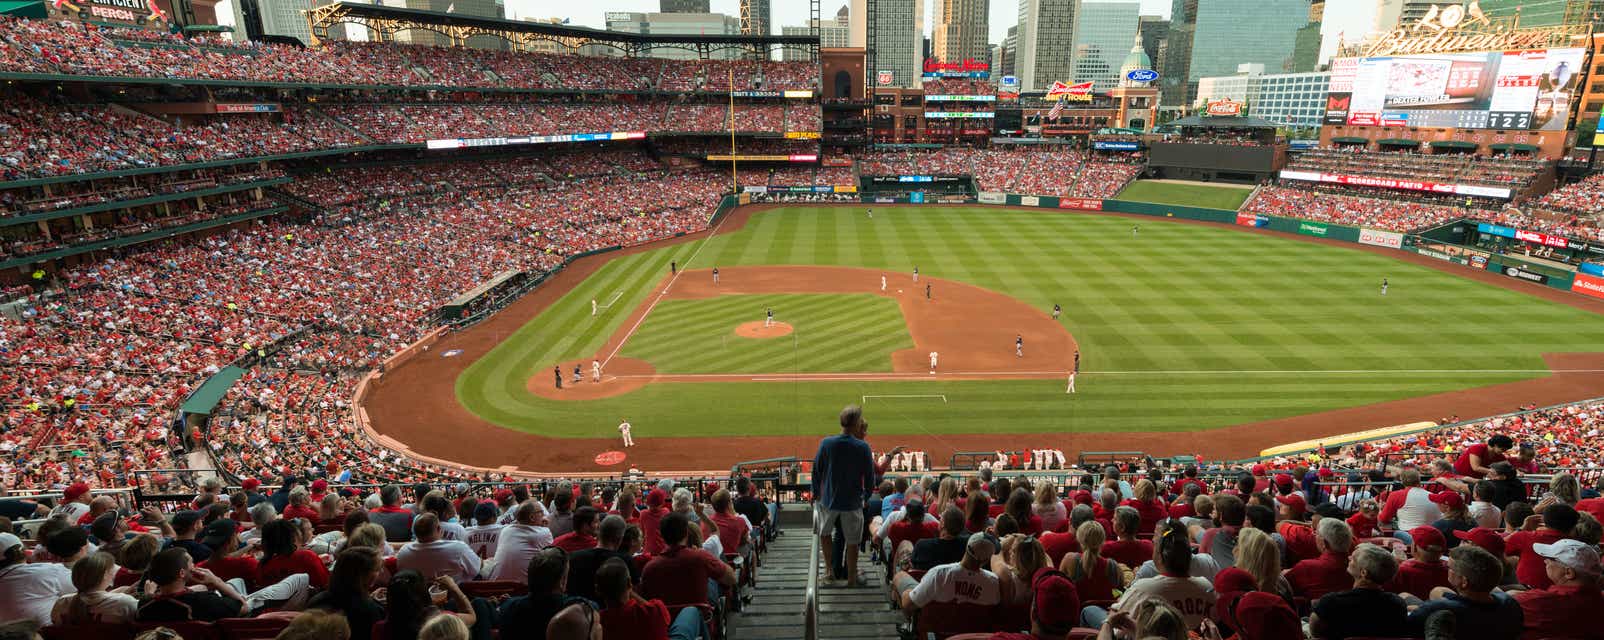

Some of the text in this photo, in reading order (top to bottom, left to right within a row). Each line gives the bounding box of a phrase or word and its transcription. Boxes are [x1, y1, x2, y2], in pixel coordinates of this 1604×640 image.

[92, 6, 134, 20] PERCH
[1367, 26, 1551, 57] Budweiser
[1132, 71, 1153, 80] Ford
[1210, 103, 1236, 113] Coca-Cola
[1490, 117, 1497, 127] 1
[1502, 117, 1513, 128] 2
[1517, 117, 1528, 128] 2
[1347, 176, 1423, 189] SCOREBOARD PATIO
[467, 532, 497, 543] MOLINA
[955, 580, 983, 599] WONG
